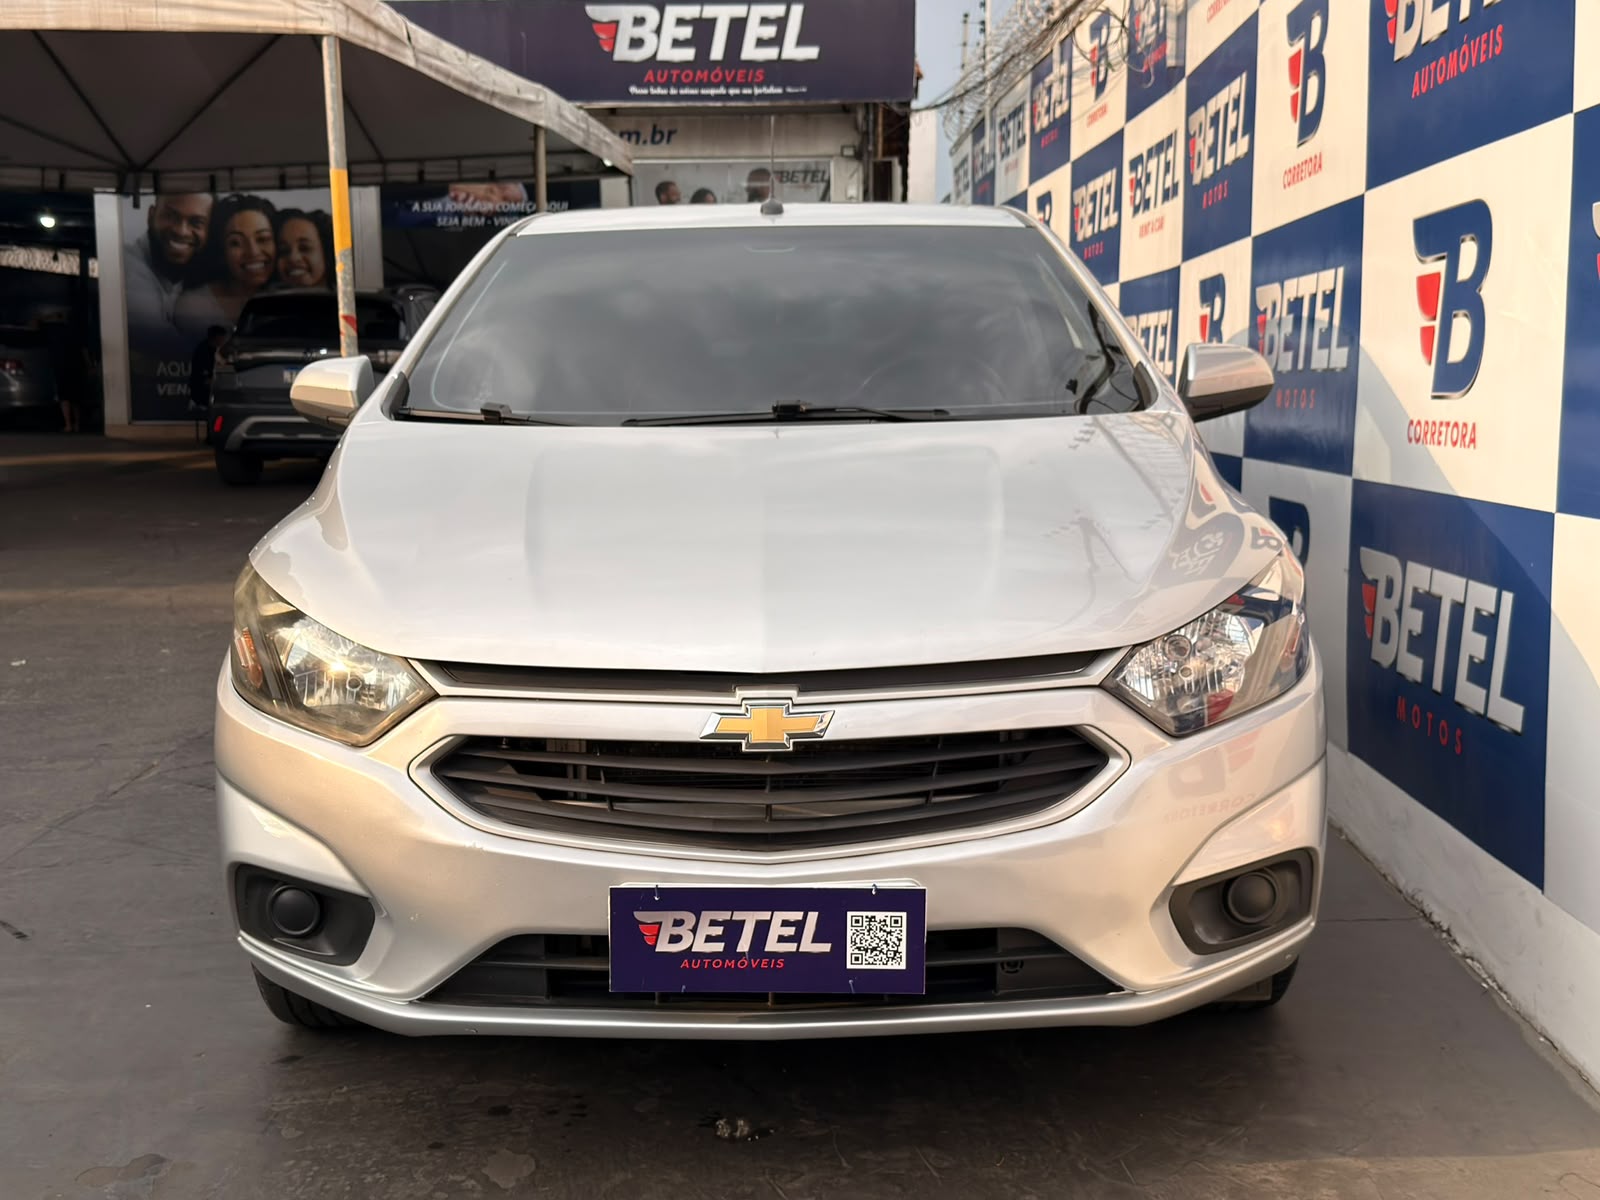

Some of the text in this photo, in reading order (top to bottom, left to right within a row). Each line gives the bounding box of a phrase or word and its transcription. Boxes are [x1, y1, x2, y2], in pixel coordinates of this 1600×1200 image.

[585, 4, 820, 62] BETEL
[643, 67, 766, 83] AUTOMÓVEIS
[1411, 24, 1504, 99] AUTOMÓVEIS
[1188, 71, 1250, 186] BETEL
[1128, 129, 1180, 219] BETEL
[1282, 151, 1323, 190] CORRETORA
[496, 201, 537, 215] COMEÇ
[1072, 167, 1119, 242] BETEL
[1202, 180, 1229, 209] MOTOS
[1255, 266, 1349, 373] BETEL
[156, 361, 192, 377] AQU
[157, 383, 191, 396] VEN
[1276, 388, 1316, 409] MOTOS
[1407, 419, 1477, 450] CORRETORA
[1359, 546, 1525, 737] BETEL
[1396, 695, 1463, 755] MOTOS
[633, 910, 833, 953] BETEL
[680, 956, 785, 969] AUTOMÓVEIS
